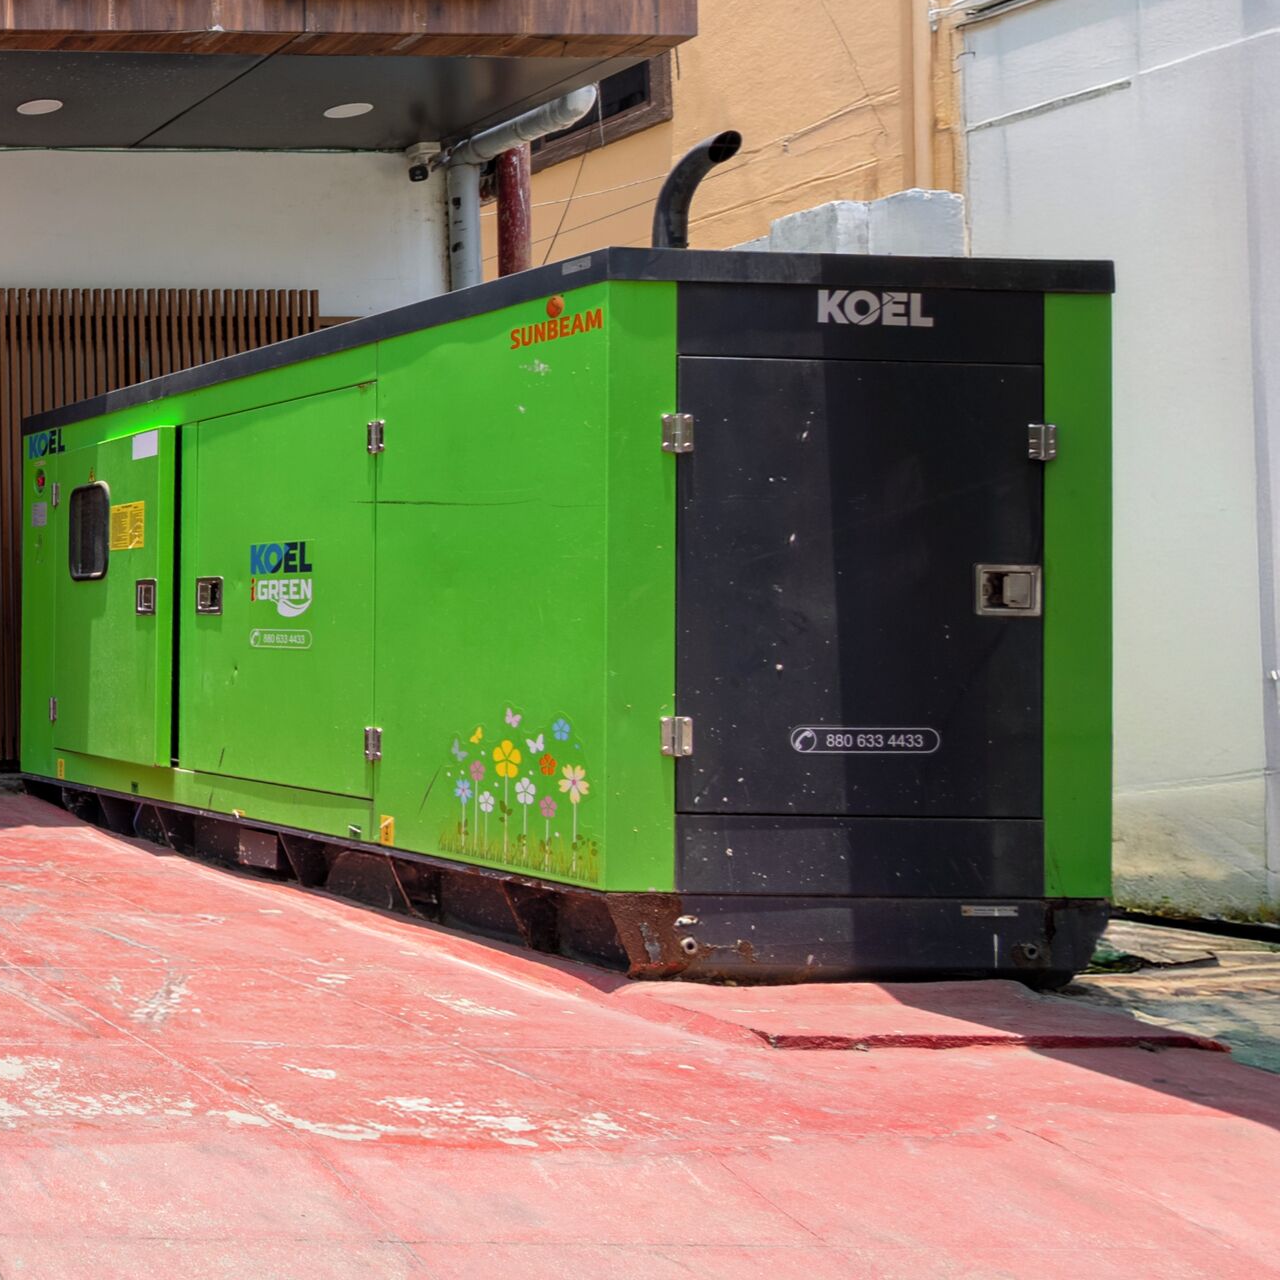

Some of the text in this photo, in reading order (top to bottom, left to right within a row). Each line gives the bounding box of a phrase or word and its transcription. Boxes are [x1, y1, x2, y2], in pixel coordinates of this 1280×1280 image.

[817, 289, 934, 327] KOEL
[510, 308, 603, 350] SUNBEAM
[28, 428, 65, 460] KOEL
[250, 541, 312, 575] KOEL
[826, 734, 924, 747] 880 633 4433
